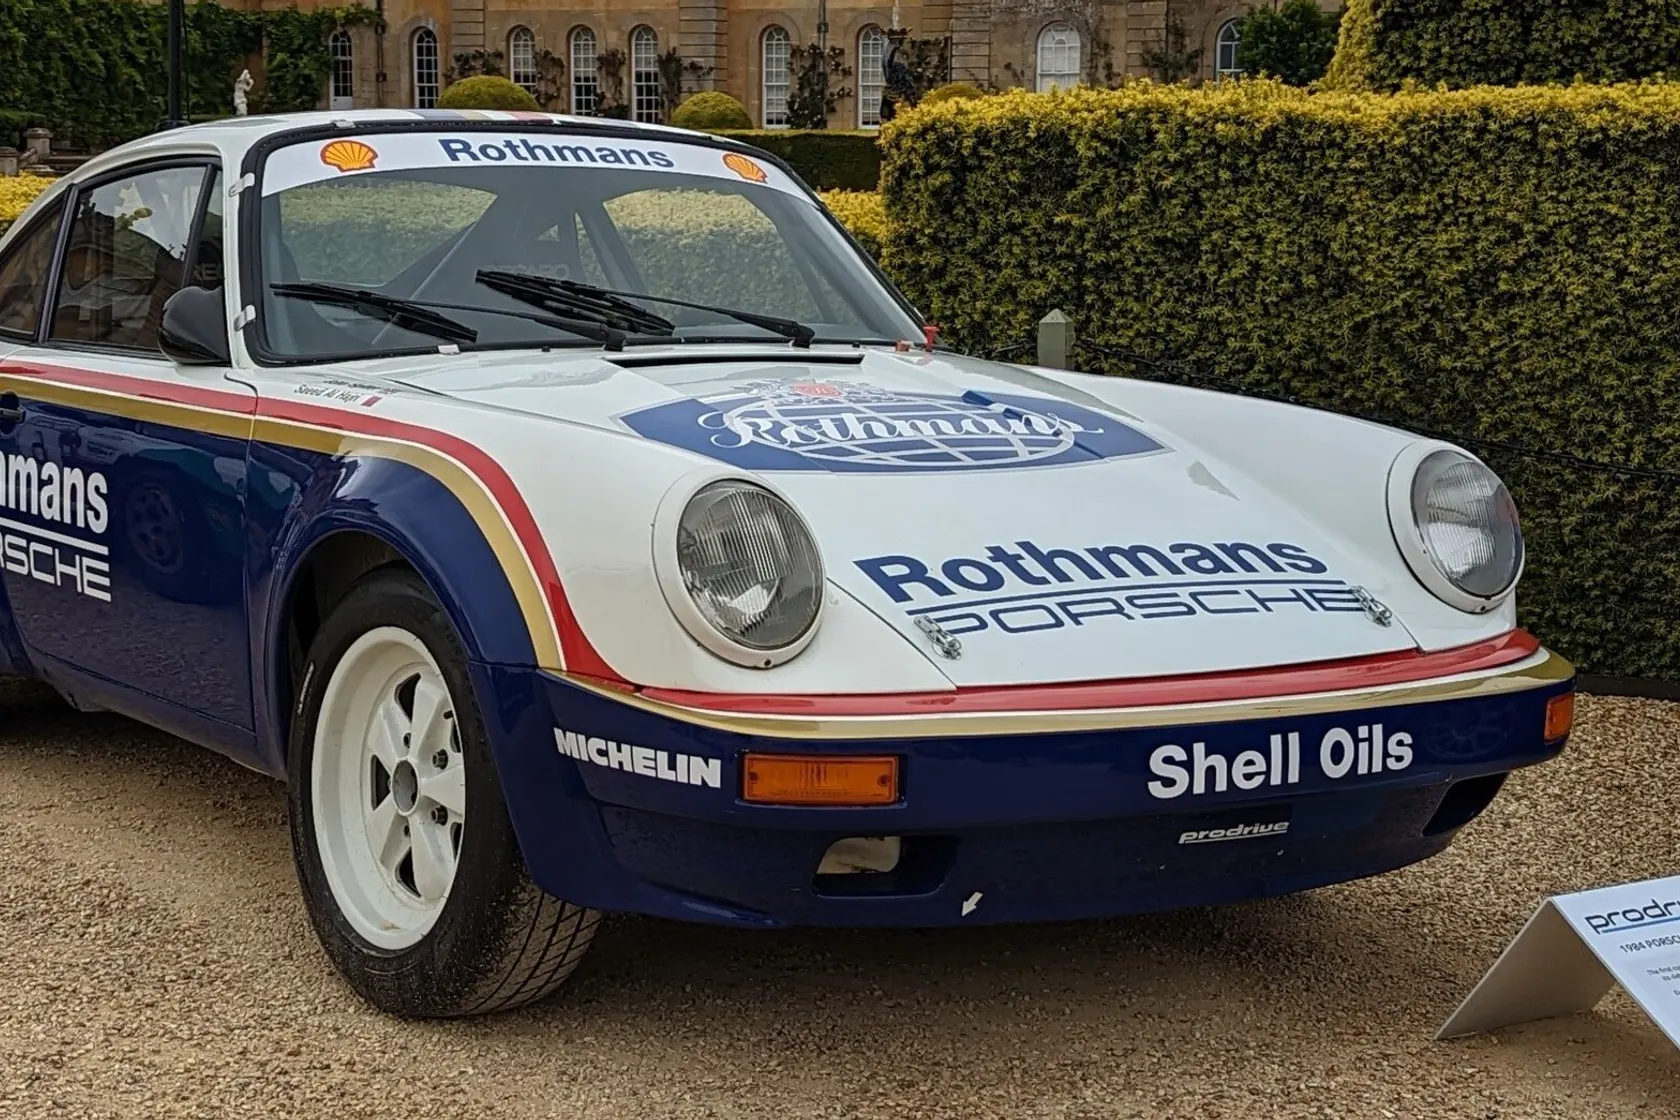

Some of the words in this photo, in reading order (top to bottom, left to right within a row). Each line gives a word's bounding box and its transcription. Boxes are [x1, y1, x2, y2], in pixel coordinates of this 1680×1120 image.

[438, 138, 675, 169] Rothmans
[697, 410, 1104, 449] Rothmans
[852, 540, 1329, 603] Rothmans
[930, 588, 1367, 635] PORSCHE
[553, 727, 722, 789] MICHELIN
[1147, 731, 1300, 799] Shell
[1319, 723, 1414, 779] Oils
[1178, 820, 1290, 844] prodrive
[1584, 898, 1680, 935] prodr
[1620, 941, 1647, 953] 1984
